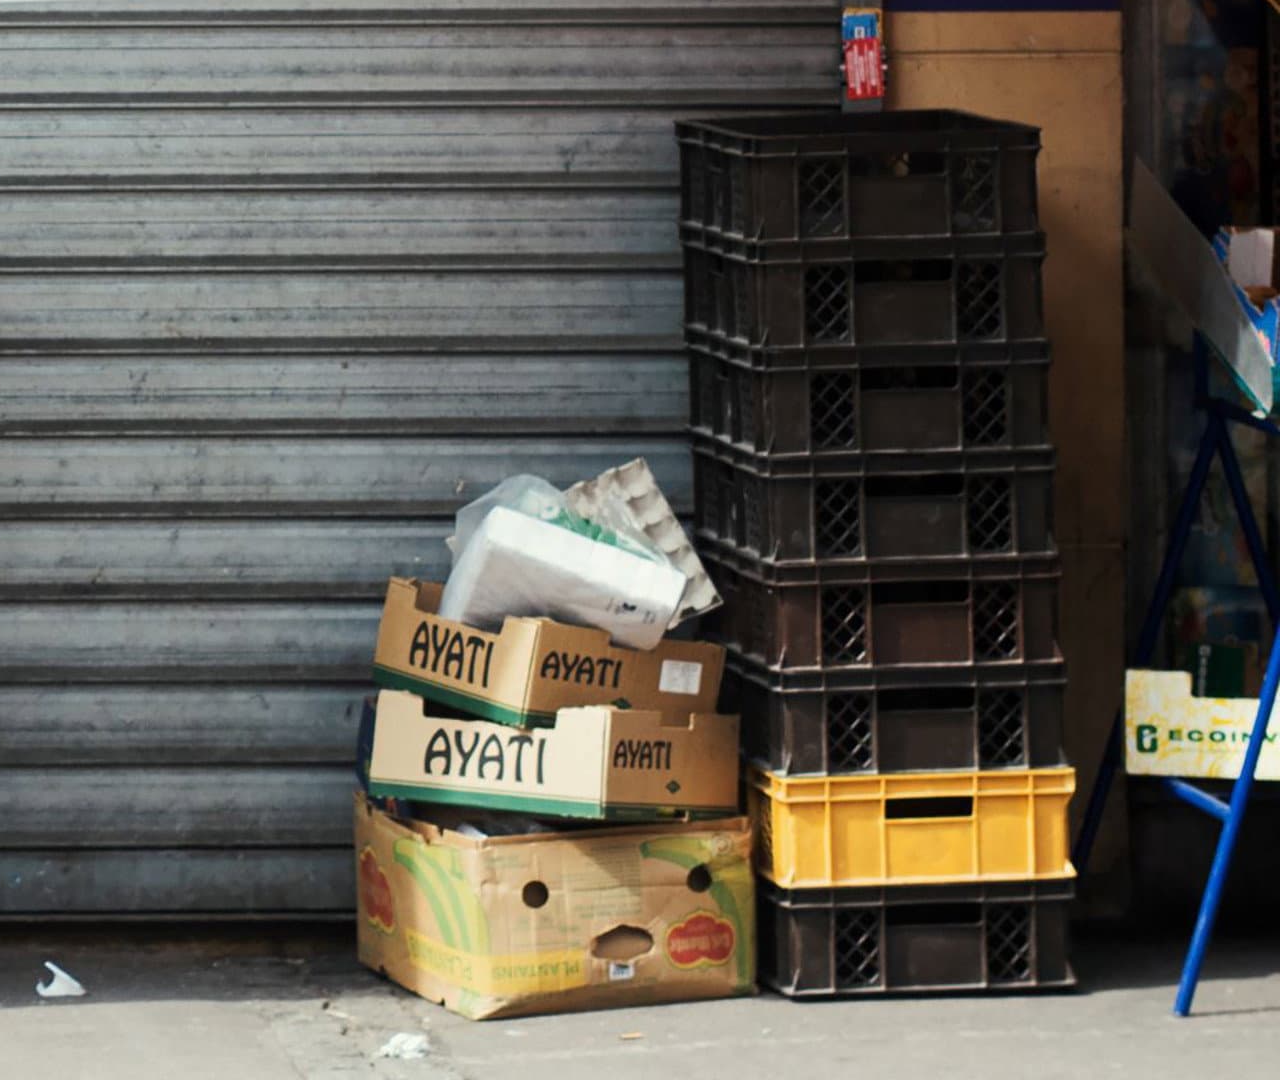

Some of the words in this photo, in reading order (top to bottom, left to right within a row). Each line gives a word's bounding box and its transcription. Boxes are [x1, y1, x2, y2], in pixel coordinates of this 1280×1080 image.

[409, 620, 494, 688] AYATI
[540, 650, 623, 689] AYATI
[424, 728, 547, 785] AYATI
[613, 739, 672, 770] AYATI
